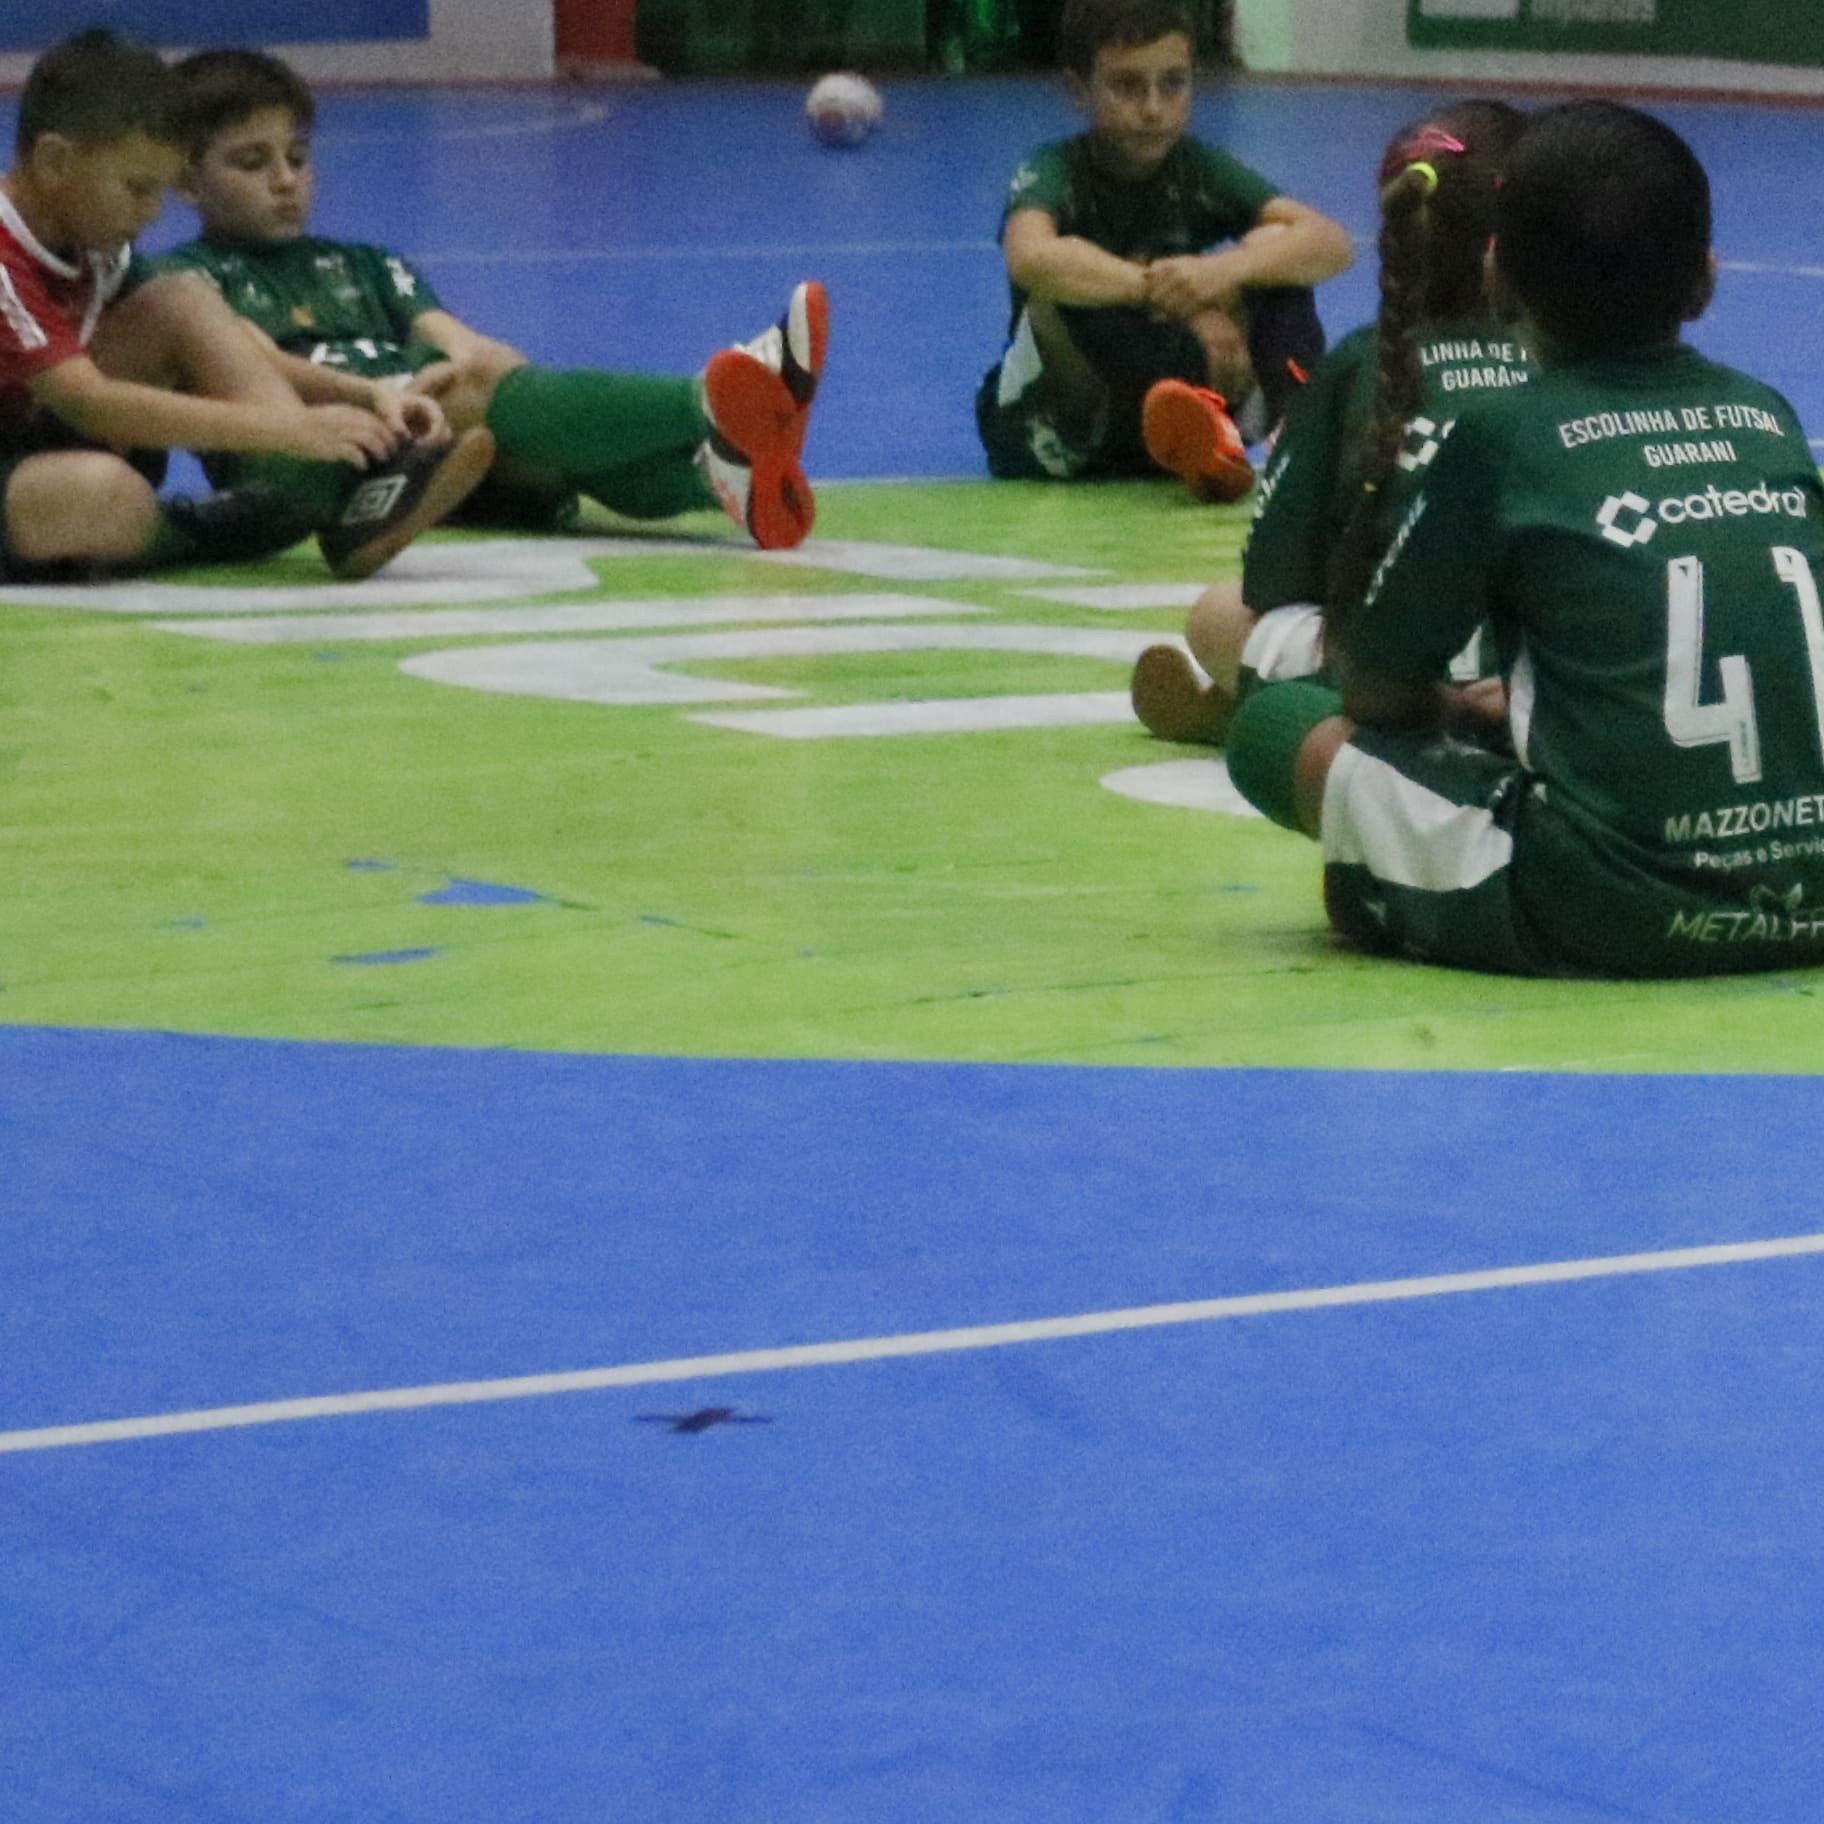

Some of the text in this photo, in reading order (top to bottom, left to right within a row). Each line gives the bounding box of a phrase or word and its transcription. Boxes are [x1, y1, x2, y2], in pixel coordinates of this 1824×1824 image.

[1557, 407, 1680, 450] ESCOLINHA
[1680, 407, 1712, 433] DE
[1643, 440, 1738, 470] GUARANI
[1657, 481, 1808, 525] catedral
